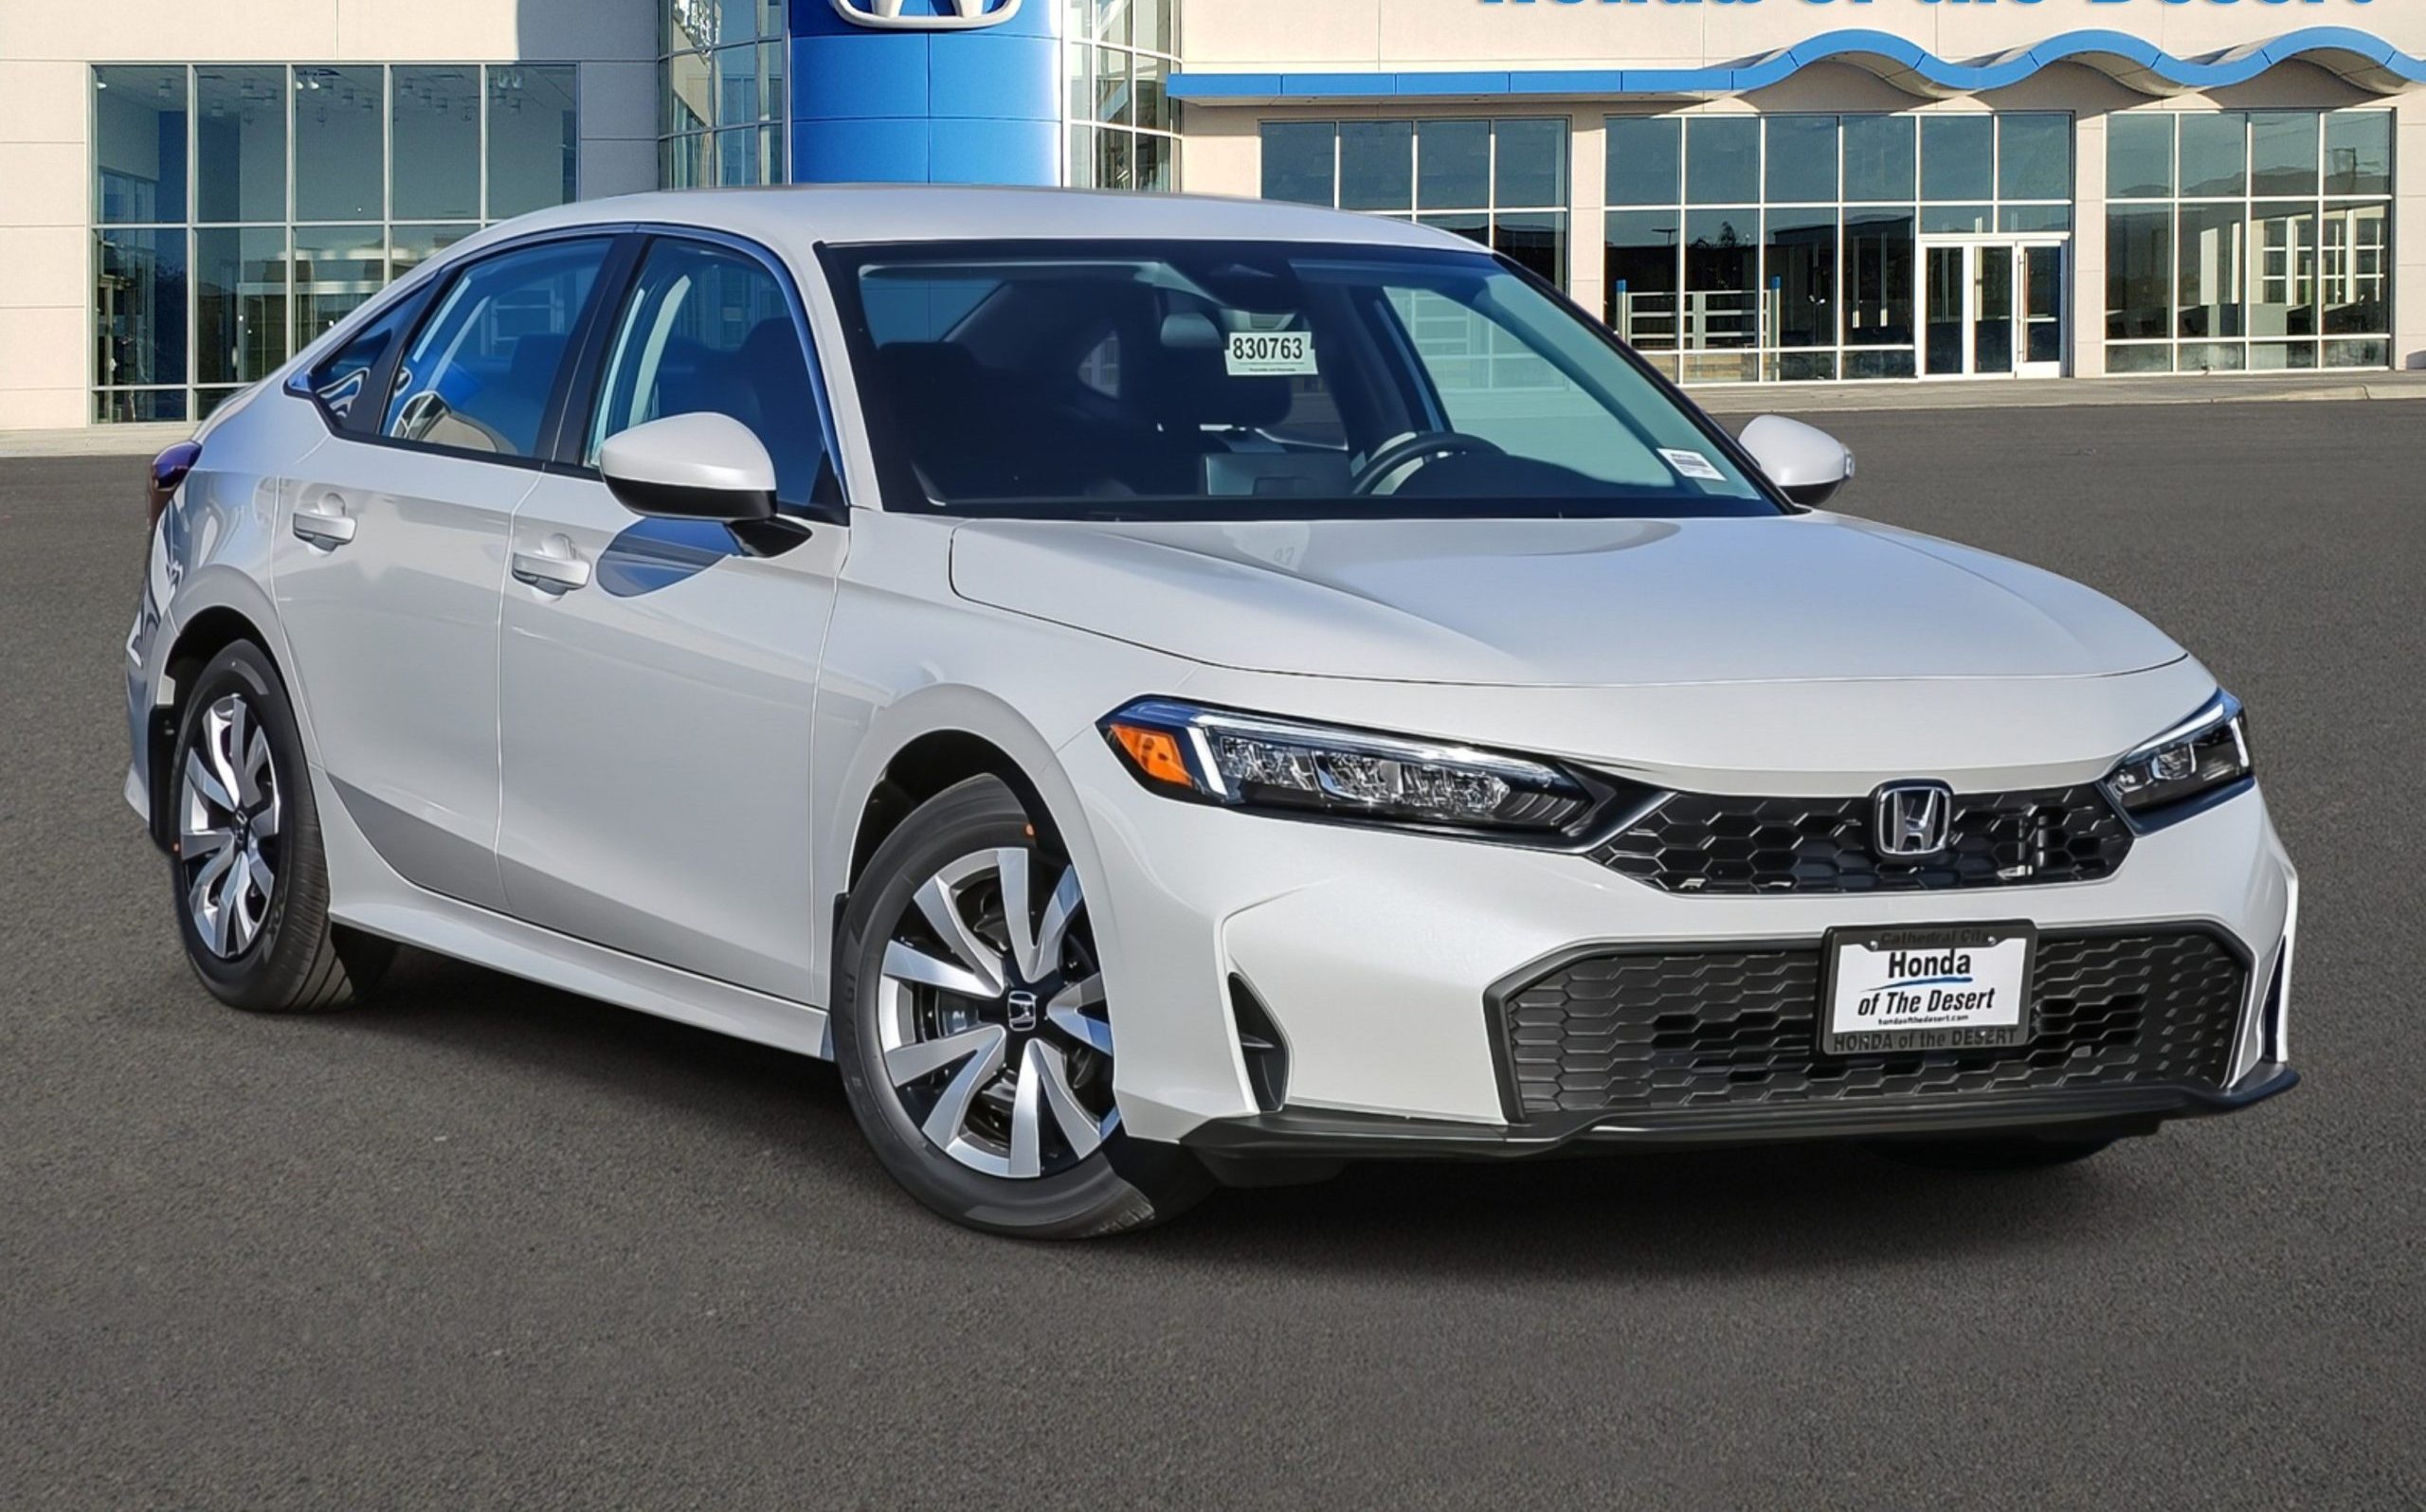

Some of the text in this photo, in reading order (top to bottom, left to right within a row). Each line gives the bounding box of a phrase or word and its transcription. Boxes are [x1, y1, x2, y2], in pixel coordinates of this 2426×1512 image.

[1233, 337, 1303, 359] 830763
[1888, 948, 1972, 979] Honda
[1857, 988, 1995, 1017] of The Desert
[1834, 1028, 2018, 1053] HONDA of the DESERT
